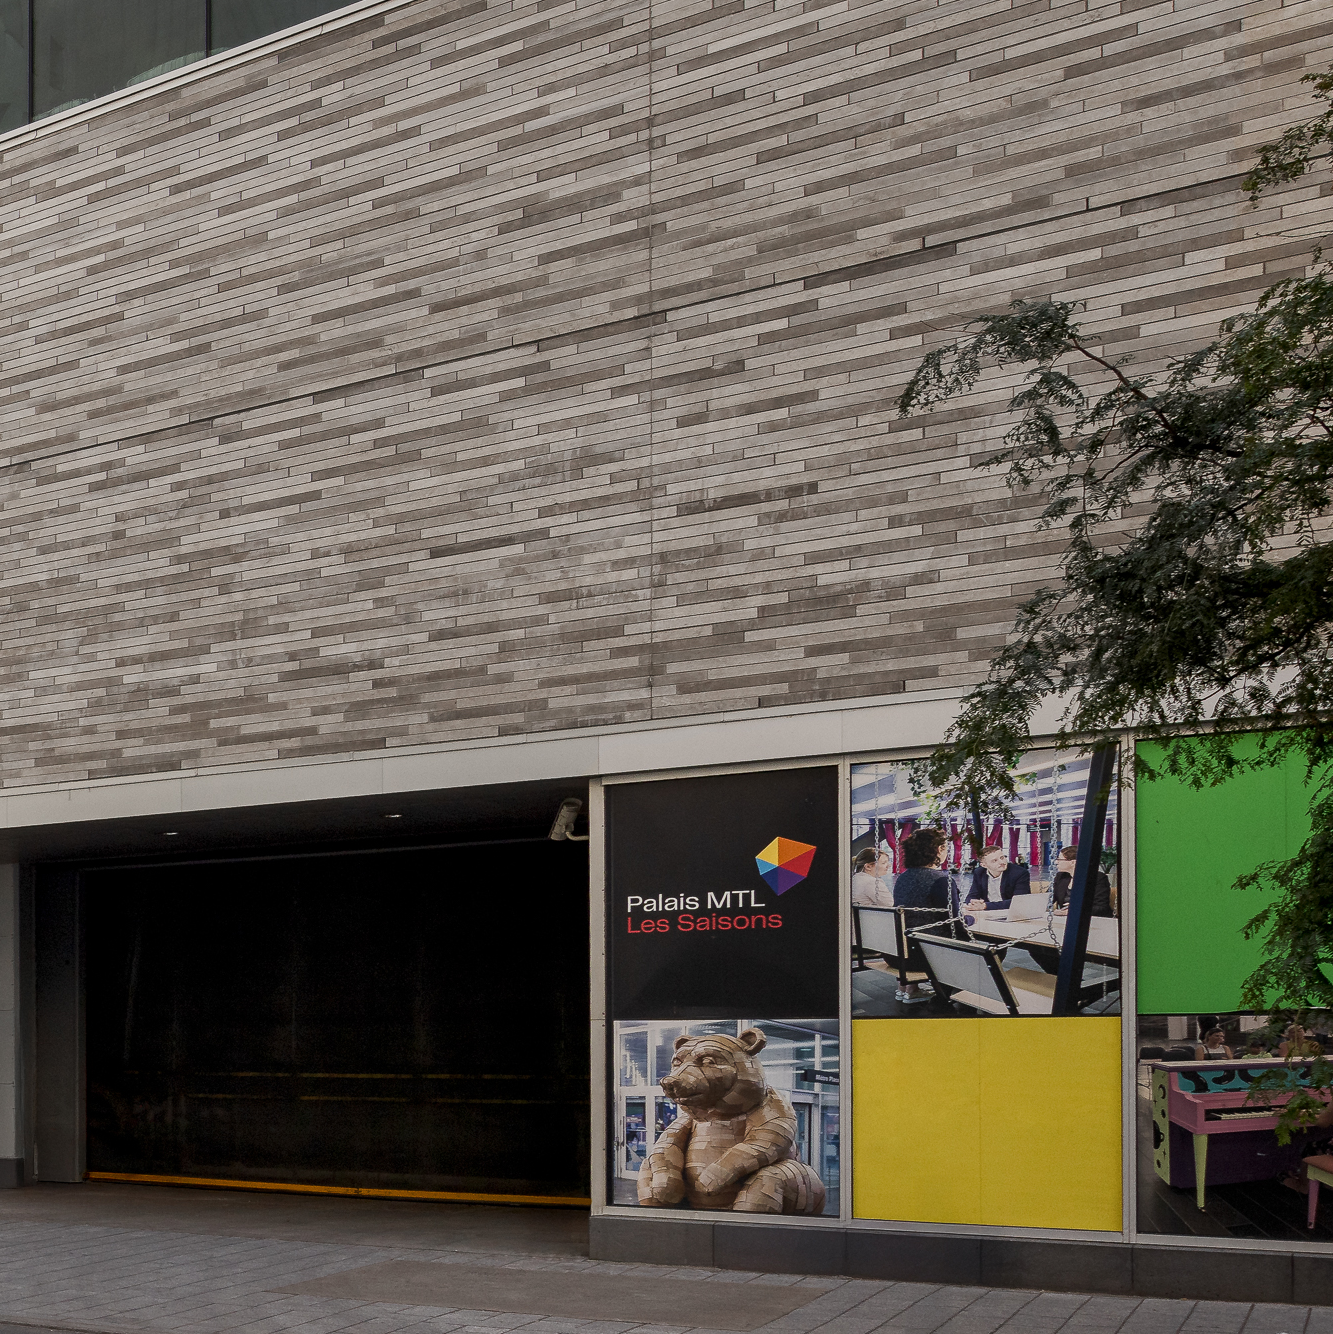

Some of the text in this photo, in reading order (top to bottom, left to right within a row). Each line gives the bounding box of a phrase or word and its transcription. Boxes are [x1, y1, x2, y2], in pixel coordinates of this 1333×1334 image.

[627, 889, 766, 913] Palais MTL
[627, 913, 783, 934] Les Saisons
